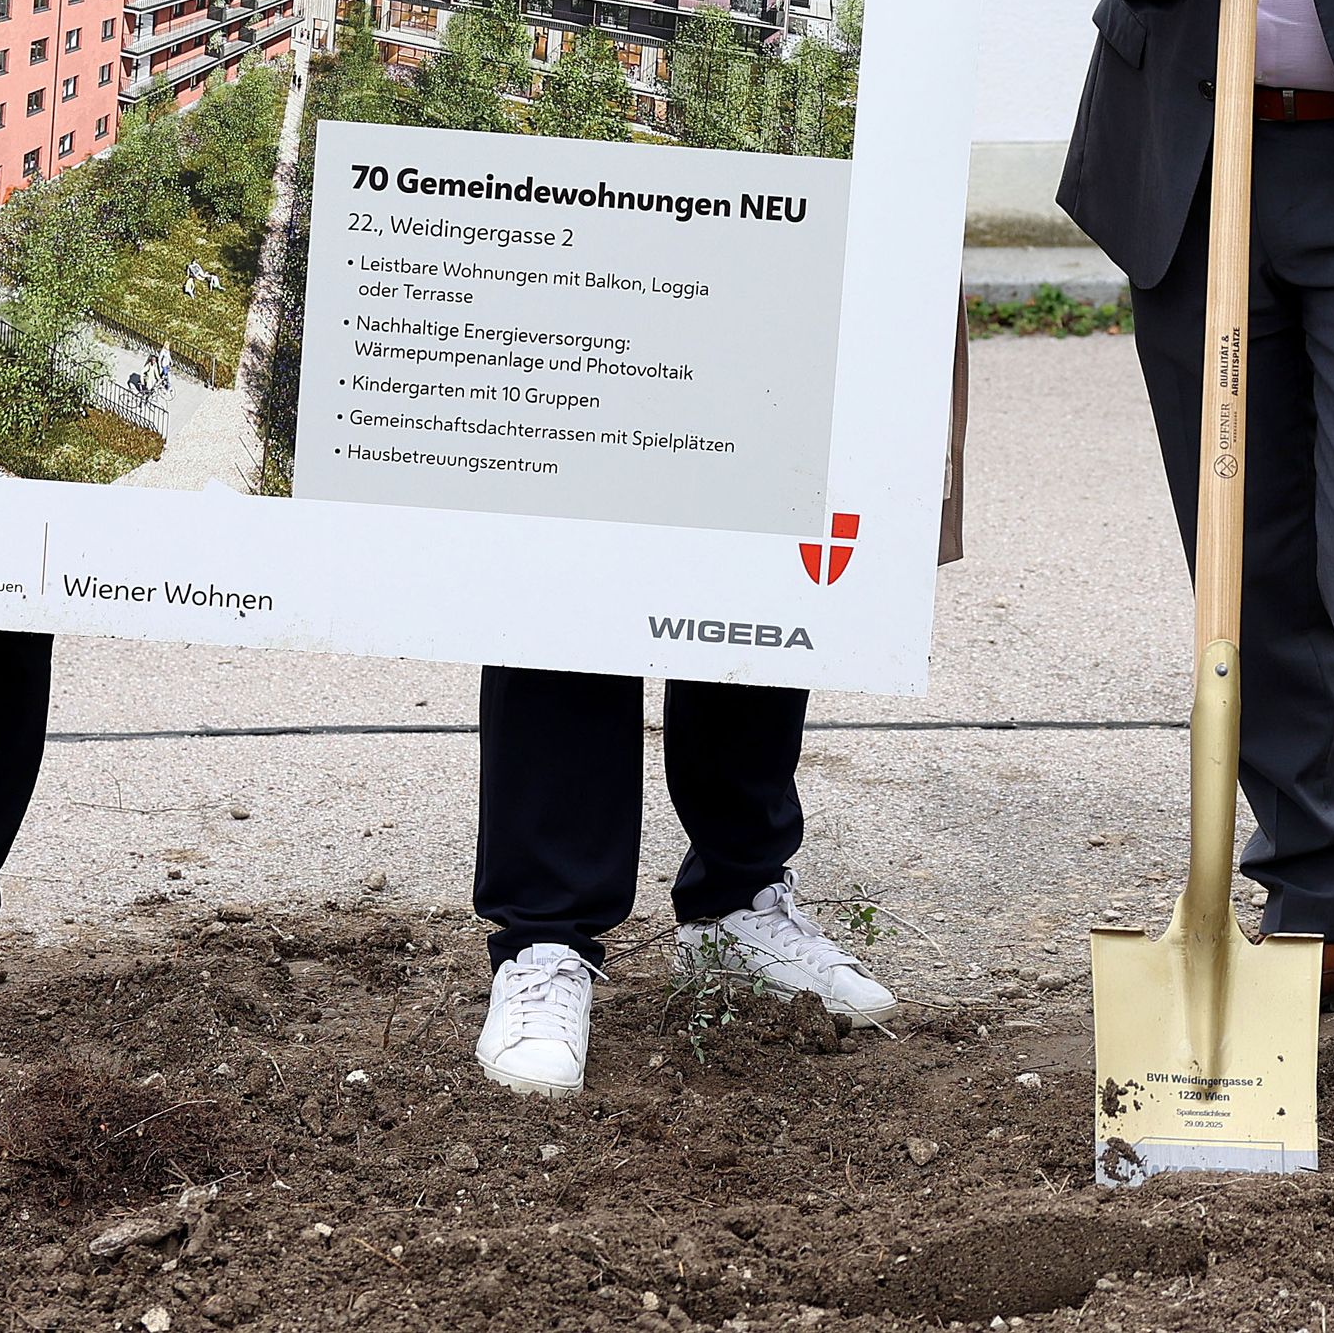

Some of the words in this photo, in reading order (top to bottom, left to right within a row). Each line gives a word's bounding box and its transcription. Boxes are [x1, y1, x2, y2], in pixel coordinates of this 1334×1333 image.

[351, 164, 389, 192] 70
[396, 167, 731, 223] Gemeindewohnungen
[739, 193, 807, 223] NEU
[347, 212, 383, 237] 22.,
[390, 215, 556, 248] Weidingergasse
[561, 228, 573, 247] 2
[358, 281, 399, 298] oder
[403, 283, 474, 304] Terrasse
[360, 254, 439, 276] Leistbare
[443, 261, 548, 287] Wohnungen
[553, 271, 581, 287] mit
[585, 271, 646, 295] Balkon,
[652, 276, 709, 300] Loggia
[356, 315, 460, 342] Nachhaltige
[464, 322, 631, 355] Energieversorgung:
[1221, 335, 1229, 343] &
[354, 339, 545, 373] Wärmepumpenanlage
[549, 356, 582, 372] und
[586, 357, 694, 381] Photovoltaik
[1219, 345, 1229, 388] QUALITÄT
[1231, 326, 1240, 396] ARBEITSPLÄTZE
[352, 374, 465, 400] Kindergarten
[469, 384, 498, 401] mit
[502, 386, 521, 403] 10
[525, 387, 600, 411] Gruppen
[349, 409, 596, 443] Gemeinschaftsdachterrassen
[600, 429, 628, 445] mit
[632, 430, 735, 453] Spielplätzen
[1219, 402, 1230, 450] OFFNER
[347, 443, 558, 474] Hausbetreuungszentrum
[63, 574, 157, 603] Wiener
[164, 581, 273, 612] Wohnen
[648, 615, 814, 651] WIGEBA
[1146, 1072, 1169, 1084] BVH
[1171, 1074, 1254, 1088] Weidingergasse
[1256, 1077, 1263, 1087] 2
[1178, 1090, 1202, 1101] 1220
[1204, 1091, 1230, 1102] Wien
